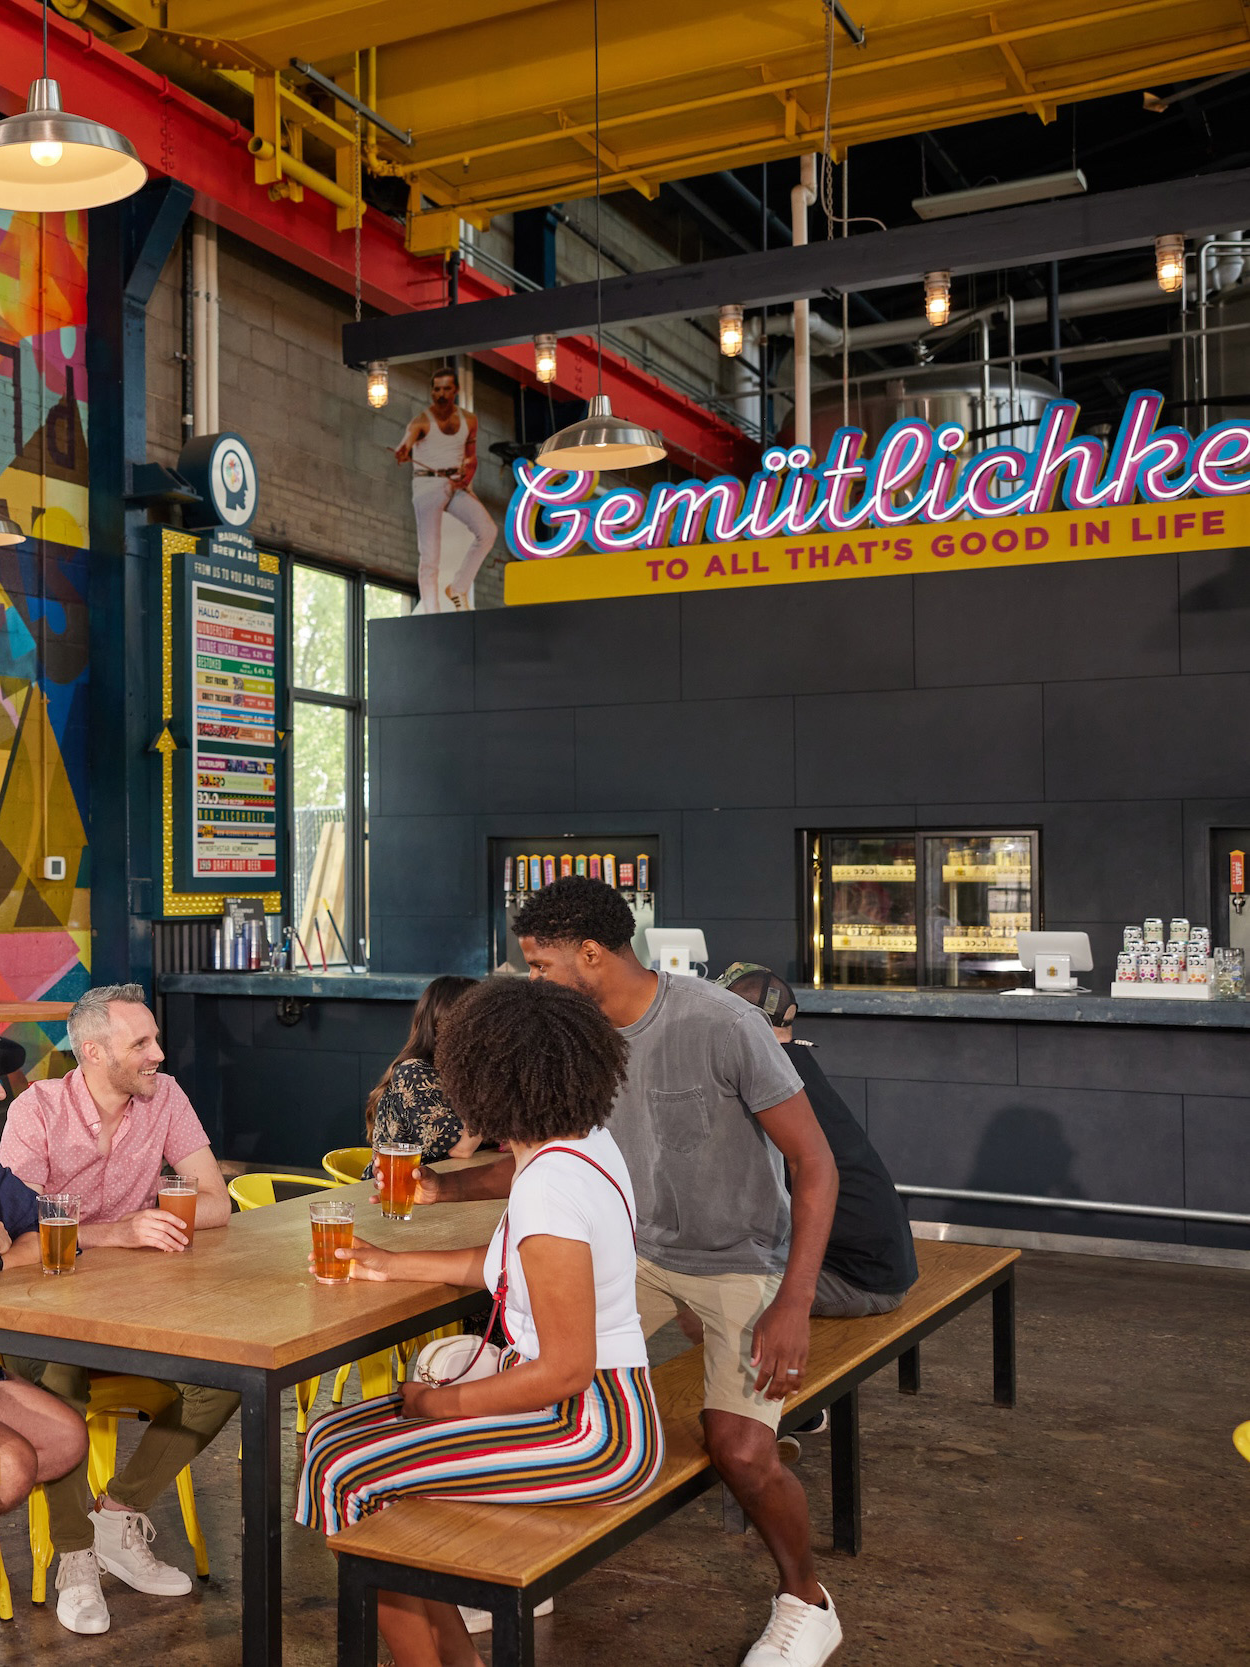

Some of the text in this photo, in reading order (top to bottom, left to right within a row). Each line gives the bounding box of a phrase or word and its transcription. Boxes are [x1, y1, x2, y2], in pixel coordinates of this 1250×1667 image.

[218, 532, 253, 549] BAUHAUS
[646, 510, 1225, 582] TO ALL THAT'S GOOD IN LIFE
[213, 544, 258, 563] BREW LABS
[194, 562, 211, 577] FROM
[212, 565, 221, 579] US
[221, 567, 230, 581] TO
[230, 570, 242, 584] YOU
[243, 572, 255, 587] AND
[198, 606, 220, 619] HALLO
[197, 809, 265, 823] NON-ALCOHOLIC
[247, 860, 261, 871] BEER
[1235, 861, 1243, 885] STUFF
